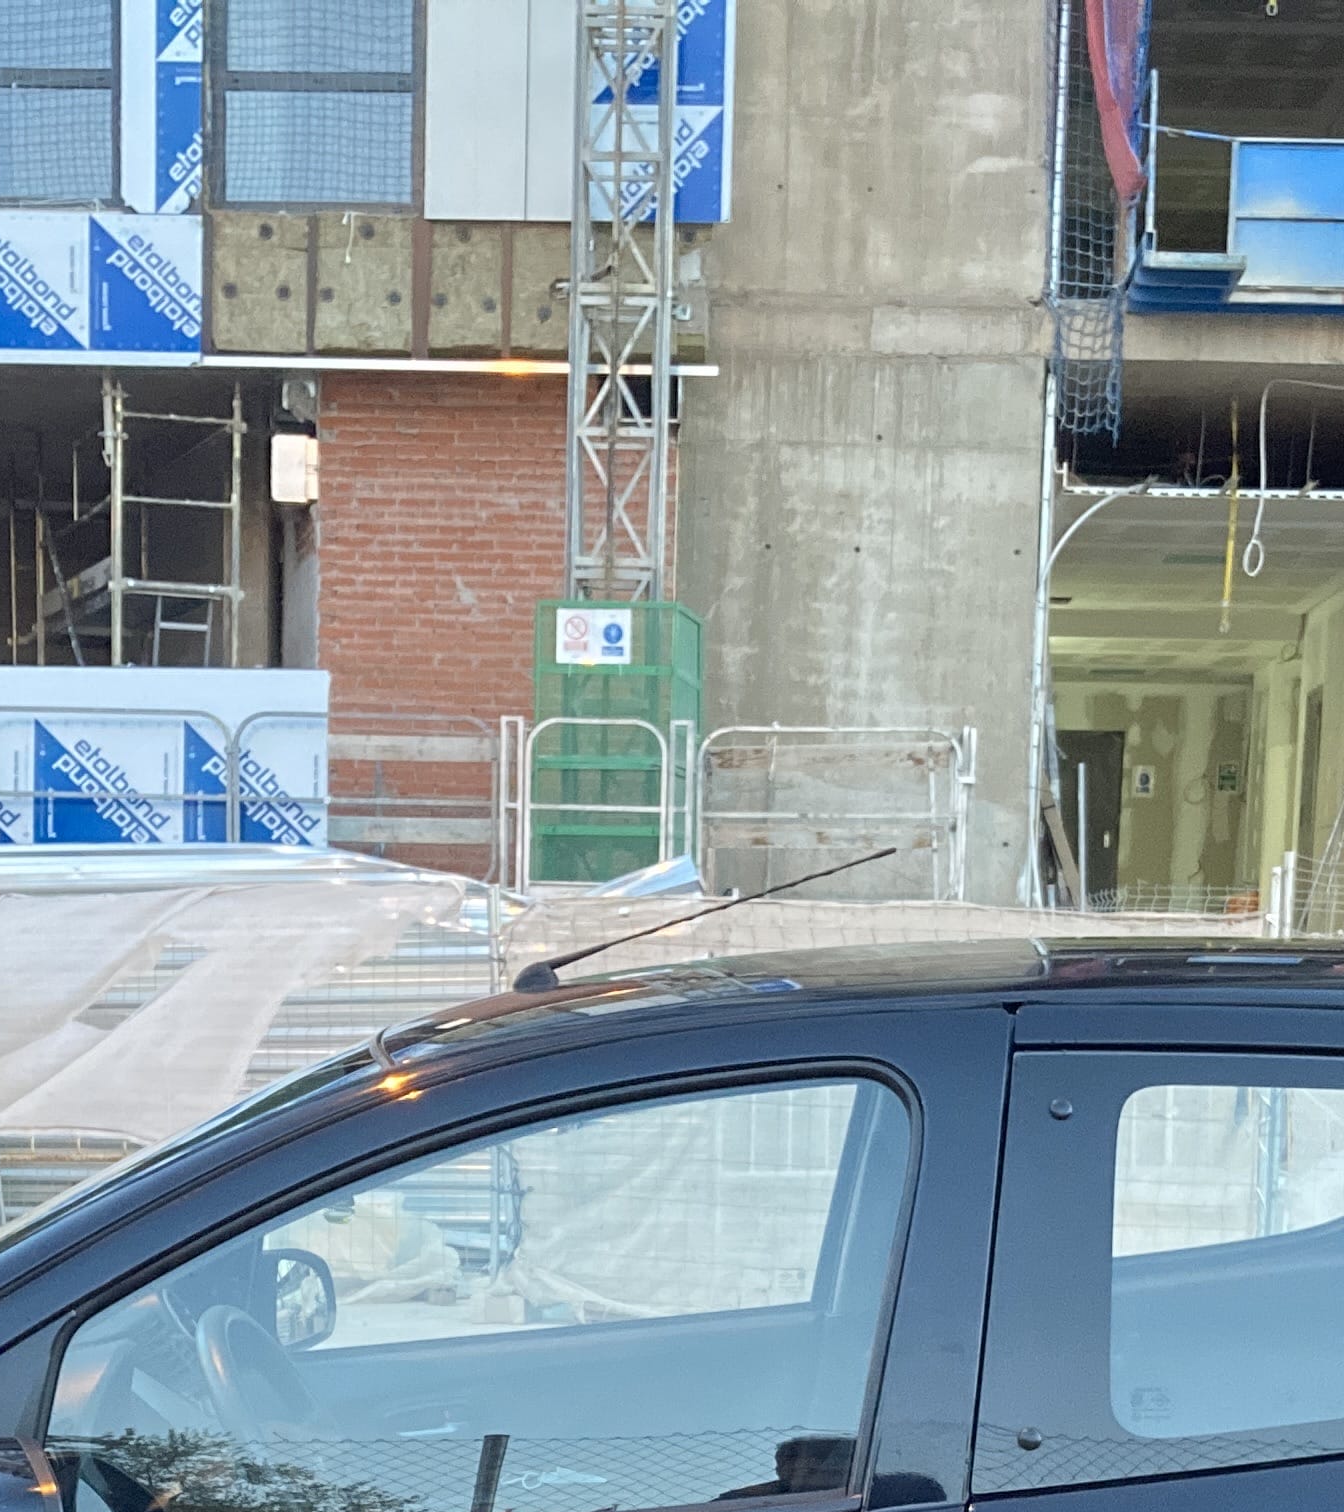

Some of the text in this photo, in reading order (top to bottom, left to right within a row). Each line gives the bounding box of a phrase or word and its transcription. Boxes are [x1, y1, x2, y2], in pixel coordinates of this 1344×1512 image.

[105, 247, 201, 338] etalbond
[74, 738, 171, 829] etalbond
[239, 749, 321, 832] talbond
